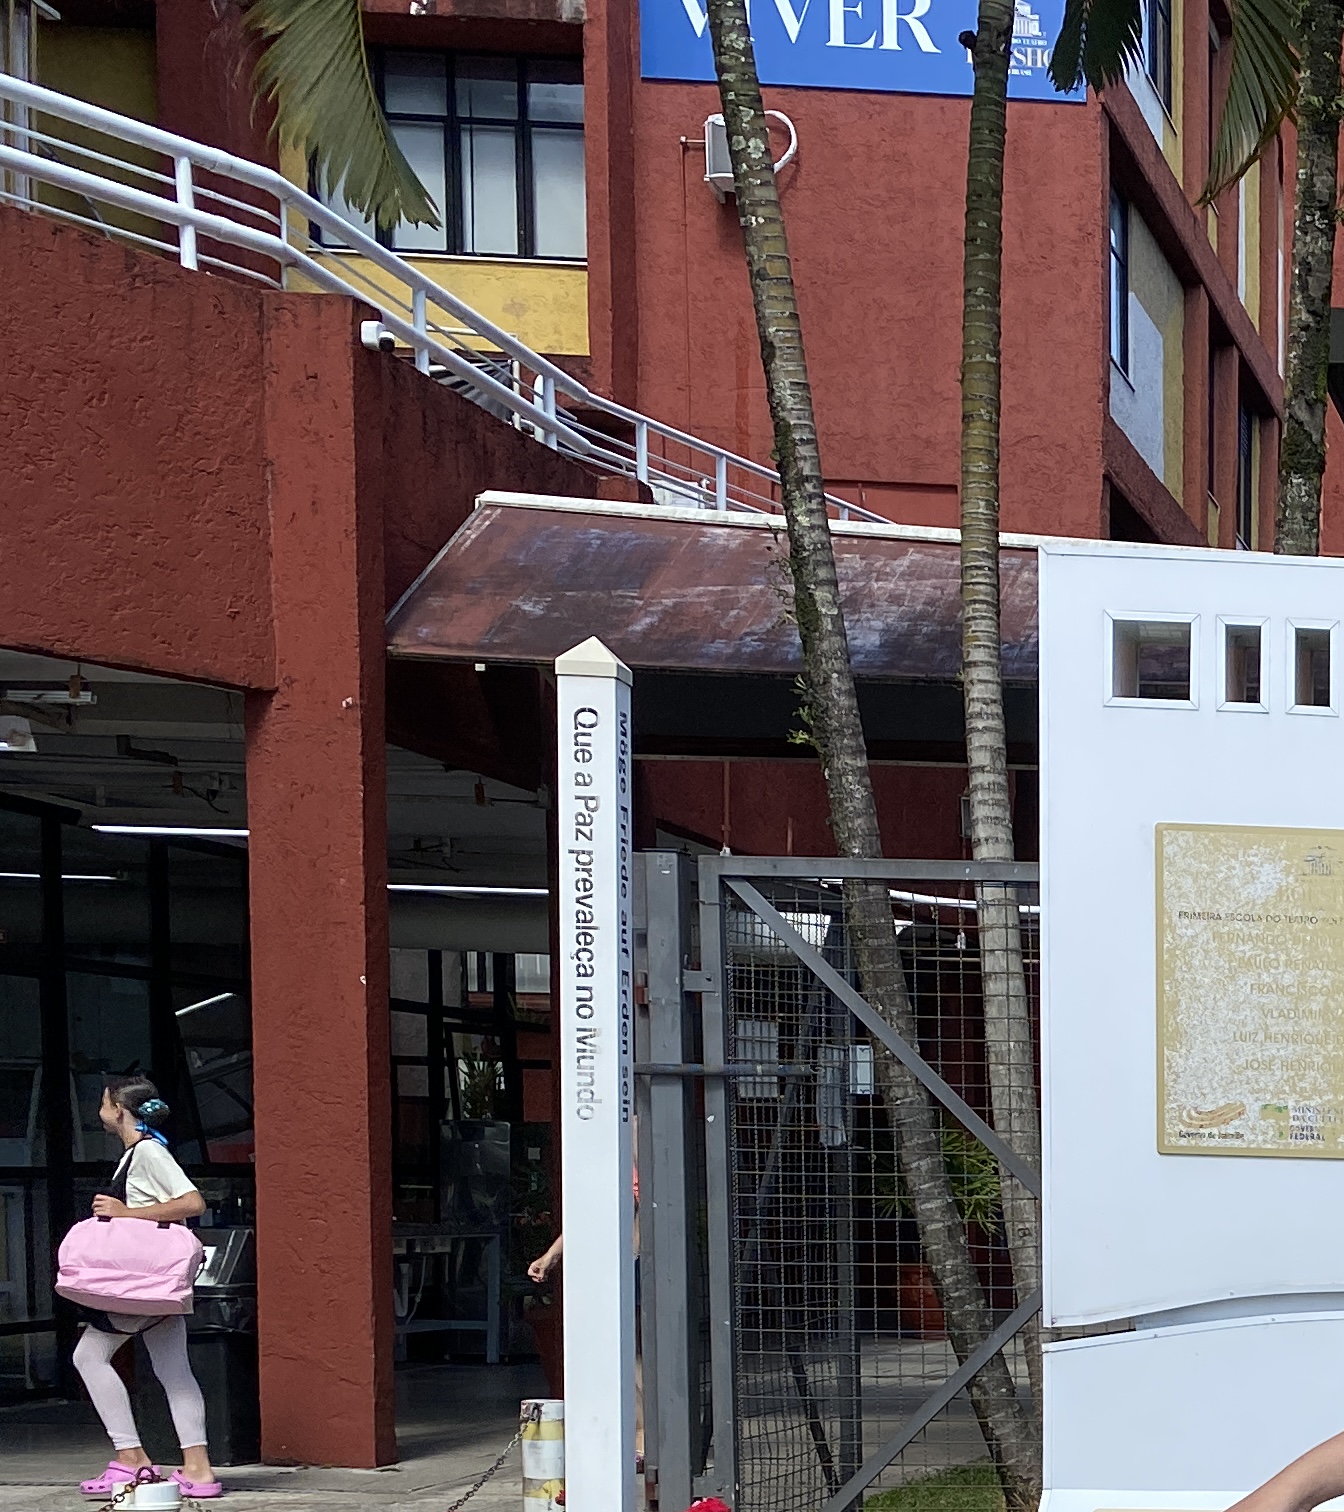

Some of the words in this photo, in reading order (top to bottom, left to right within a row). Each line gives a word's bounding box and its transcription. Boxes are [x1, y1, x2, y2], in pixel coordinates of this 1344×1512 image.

[682, 0, 941, 53] VVER
[573, 707, 600, 763] Que
[574, 772, 593, 787] a
[574, 795, 600, 841] Paz
[568, 849, 600, 978] prevaleça
[575, 985, 595, 1019] no
